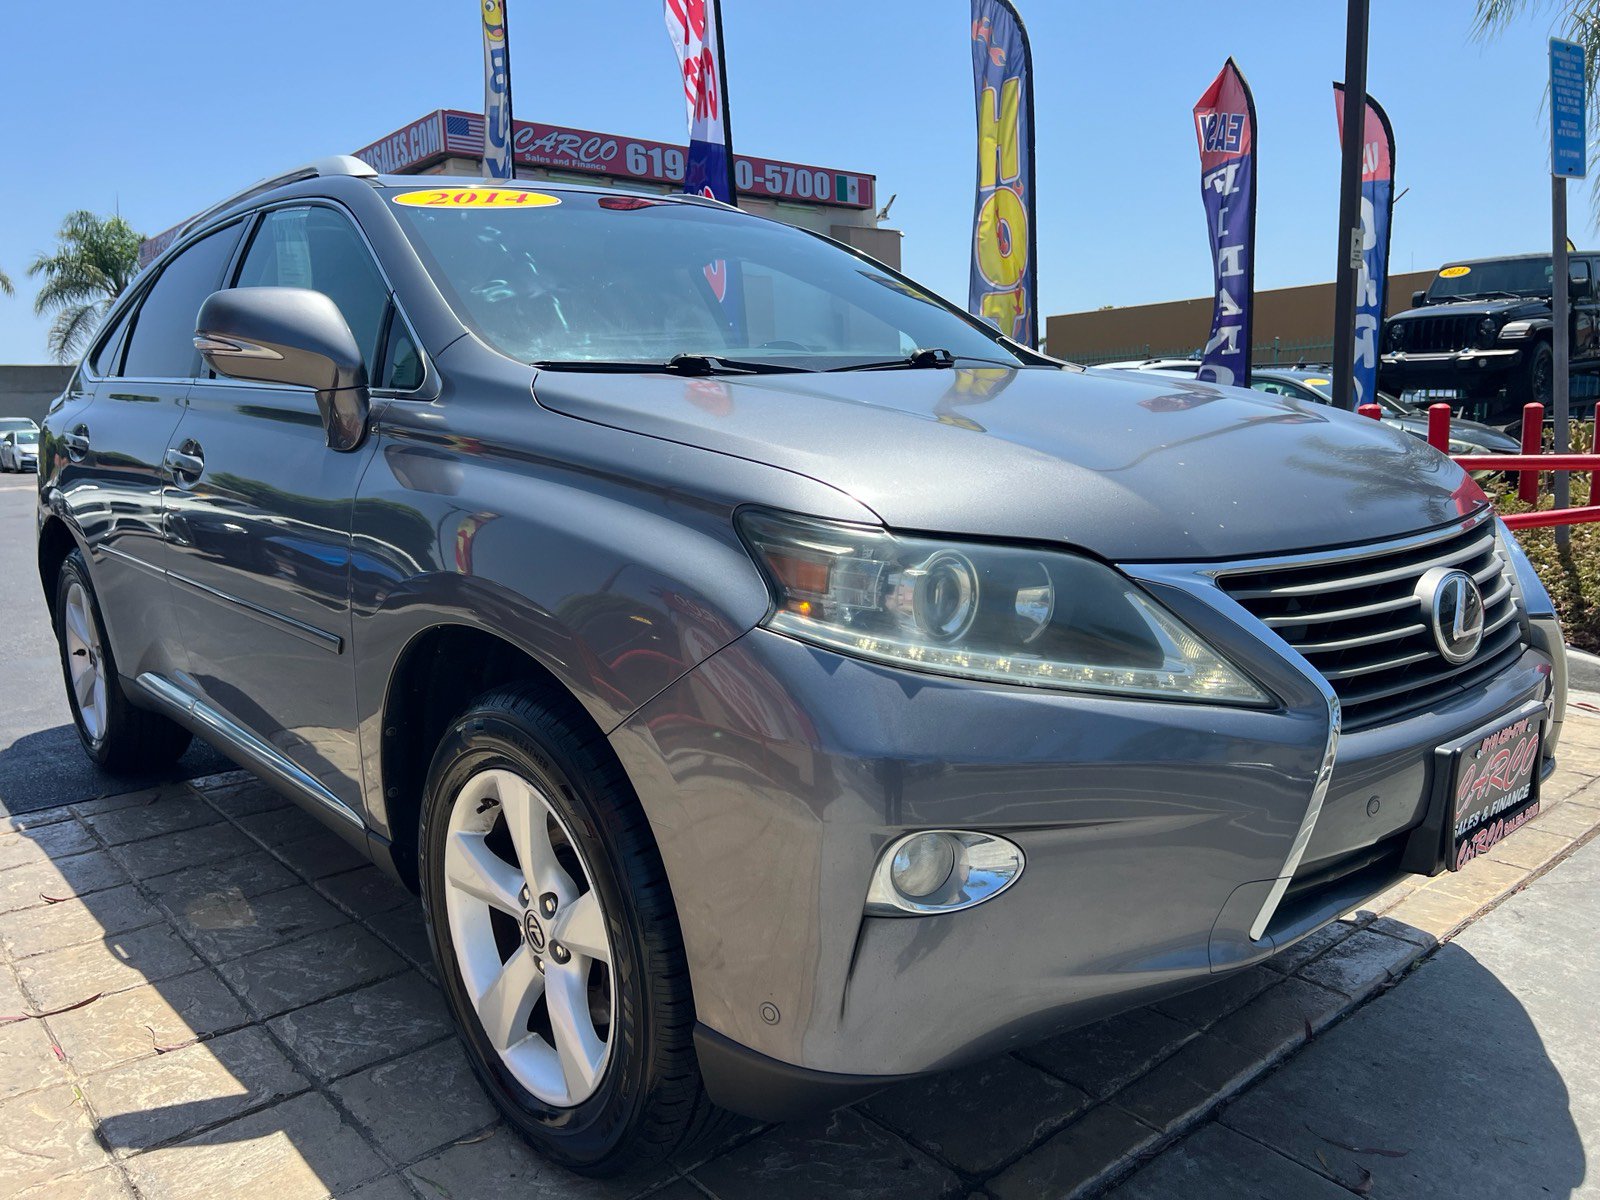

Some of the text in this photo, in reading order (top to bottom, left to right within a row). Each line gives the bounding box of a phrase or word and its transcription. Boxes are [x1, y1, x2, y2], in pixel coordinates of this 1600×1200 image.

[514, 127, 619, 163] CARCO
[525, 153, 607, 171] Sales and Finance
[428, 193, 528, 205] 2014
[976, 76, 1028, 340] HOT
[1456, 733, 1539, 821] CARCO
[1481, 806, 1489, 823] &
[1490, 783, 1531, 817] FINANCE
